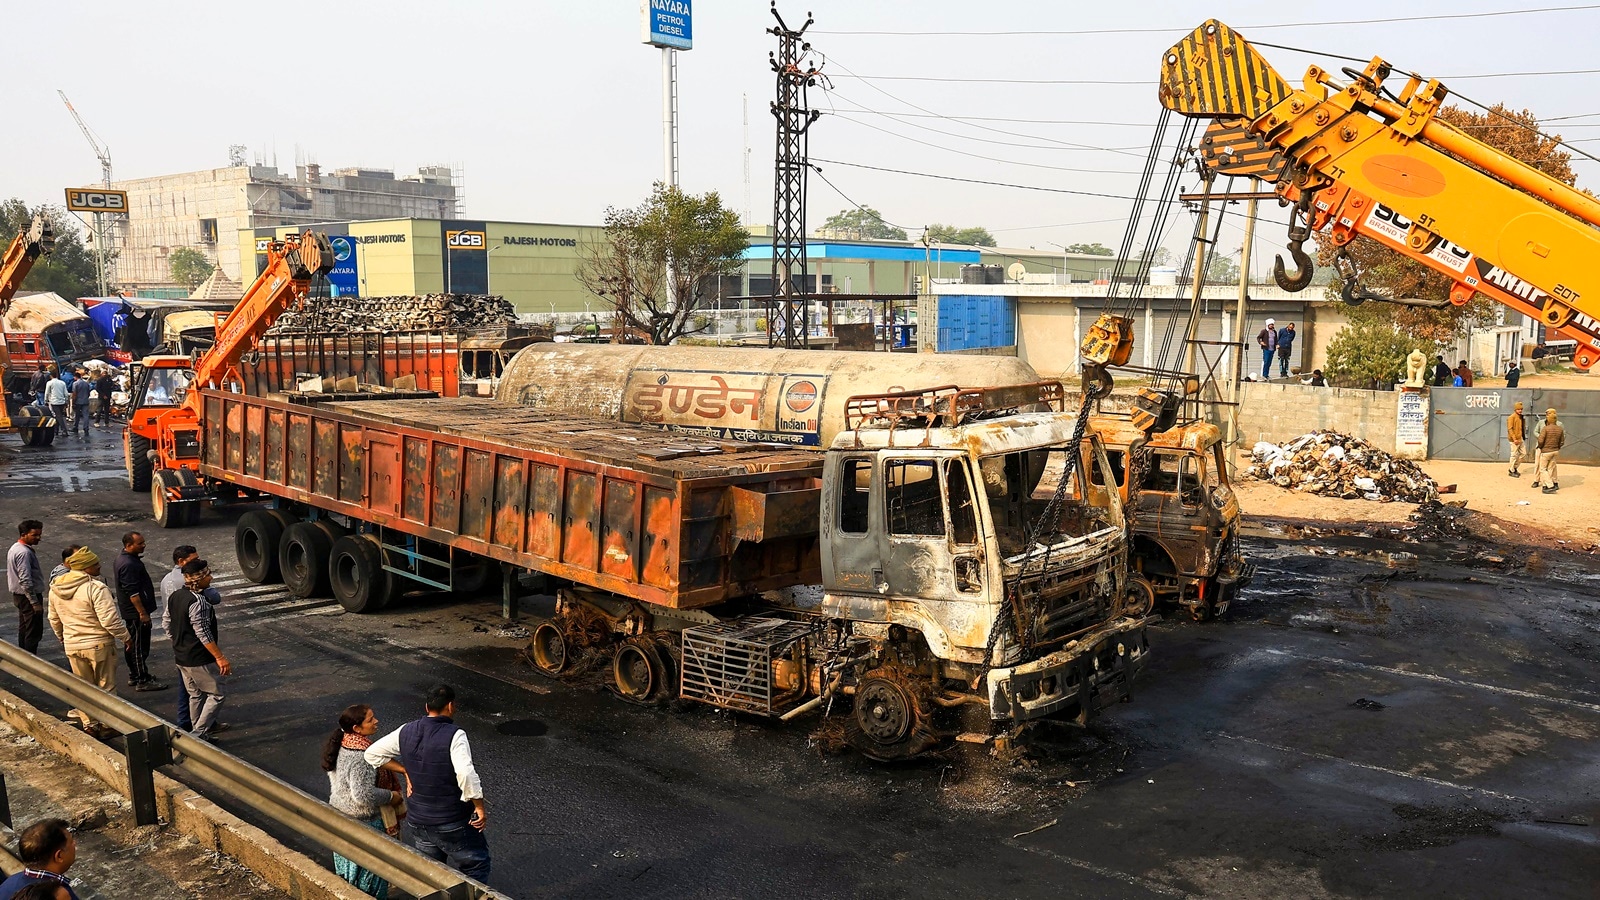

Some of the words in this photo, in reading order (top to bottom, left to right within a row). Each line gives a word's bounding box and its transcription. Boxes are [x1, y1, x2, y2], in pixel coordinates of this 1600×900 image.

[651, 0, 690, 16] NAYARA
[657, 13, 686, 27] PETROL
[658, 24, 685, 36] DIESEL
[1331, 165, 1346, 179] 7T
[72, 193, 123, 208] JCB
[1418, 213, 1436, 228] 9T
[378, 234, 406, 244] MOTORS
[450, 234, 482, 246] JCB
[504, 236, 538, 246] RAJESH
[540, 237, 576, 247] MOTORS
[1368, 219, 1398, 237] BRAND
[1434, 251, 1464, 269] TRUST
[1466, 276, 1478, 286] 10T
[1553, 283, 1581, 303] 20T
[1465, 392, 1501, 409] अरावली
